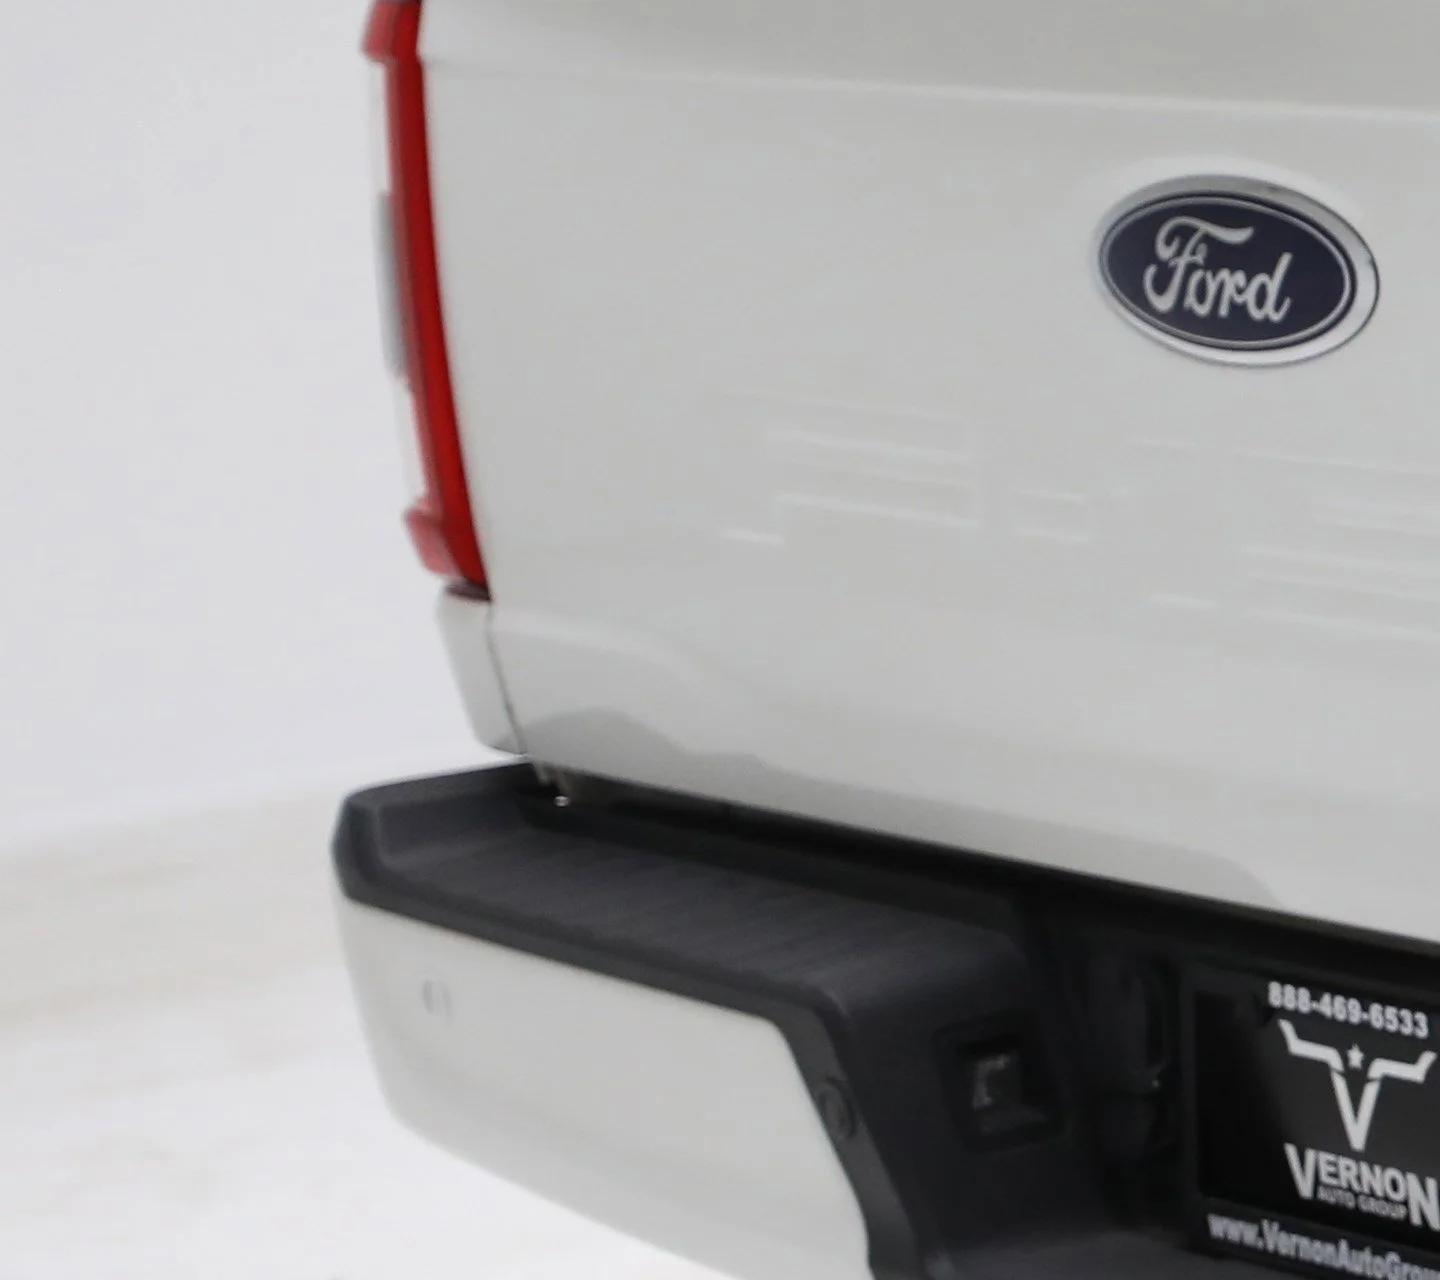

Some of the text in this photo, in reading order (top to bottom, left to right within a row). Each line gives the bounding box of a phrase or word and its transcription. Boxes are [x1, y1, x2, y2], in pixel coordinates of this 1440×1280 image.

[1142, 214, 1293, 324] Ford
[1267, 980, 1430, 1040] 888-469-6533
[1317, 1185, 1407, 1221] AUTO GROUP
